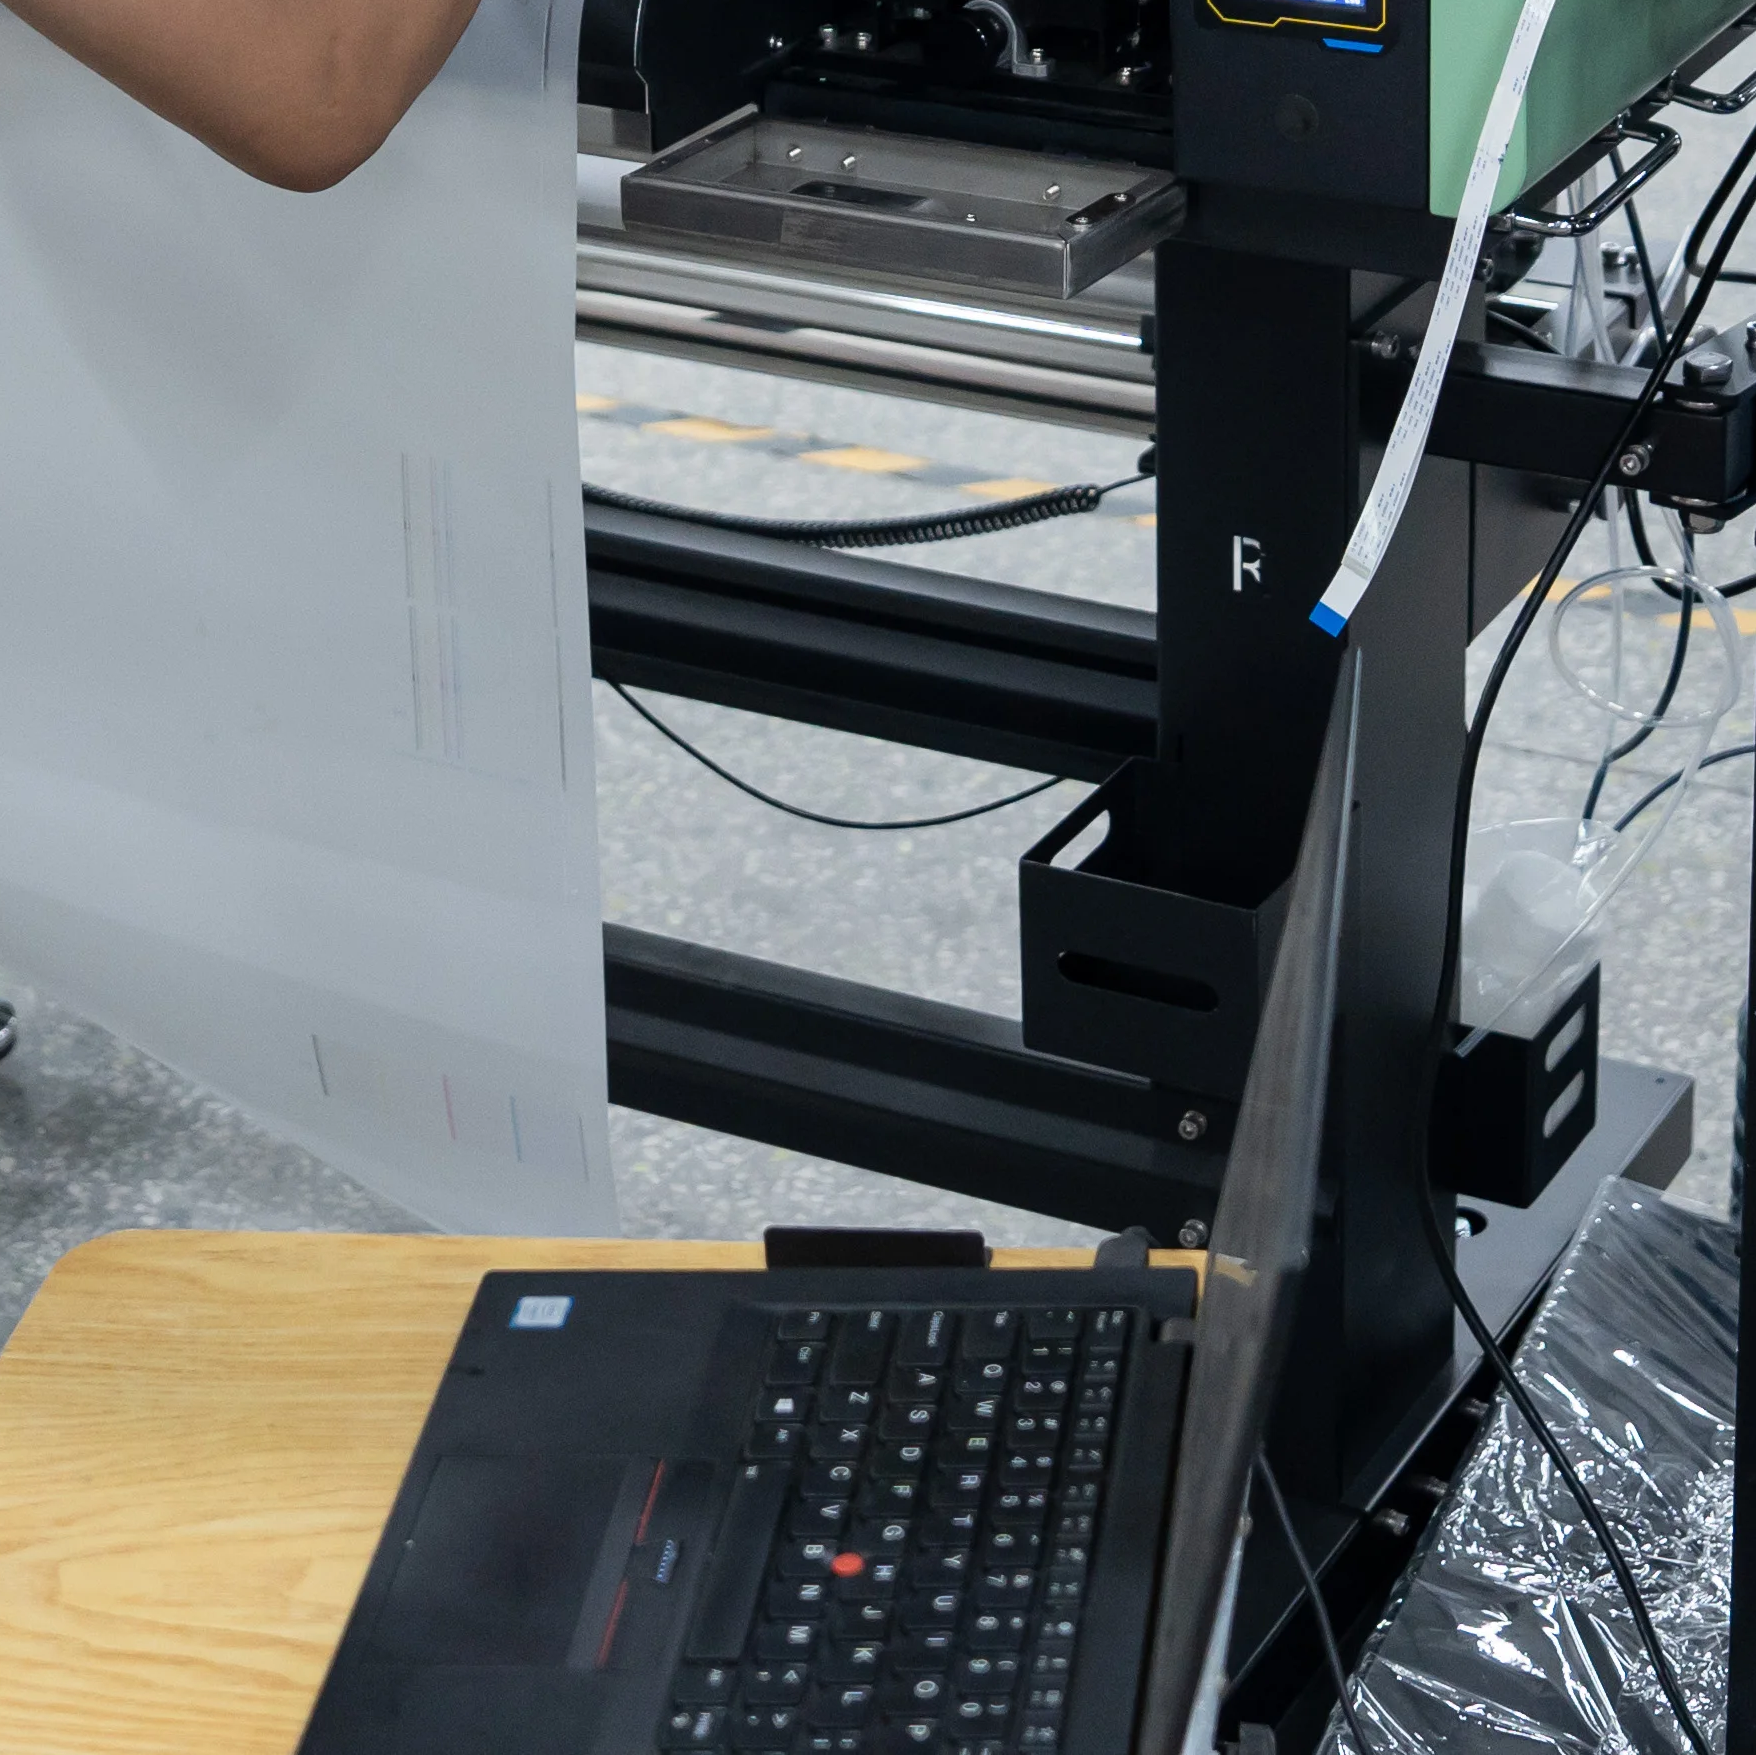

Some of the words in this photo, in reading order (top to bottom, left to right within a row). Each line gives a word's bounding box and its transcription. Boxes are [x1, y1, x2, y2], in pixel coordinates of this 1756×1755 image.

[1233, 535, 1266, 592] R
[807, 1311, 821, 1324] Fn
[927, 1310, 945, 1347] CapsLock
[982, 1363, 1004, 1378] Q
[917, 1371, 938, 1387] A
[1024, 1380, 1043, 1394] 2
[848, 1391, 870, 1404] Z
[908, 1409, 930, 1423] S
[974, 1400, 995, 1418] W
[1016, 1417, 1036, 1431] 3
[839, 1428, 860, 1442] X
[966, 1437, 989, 1451] E
[900, 1447, 922, 1461] D
[1009, 1456, 1028, 1469] 4
[829, 1466, 852, 1481] C
[959, 1474, 981, 1490] R
[891, 1485, 913, 1498] F
[1000, 1495, 1021, 1508] 5
[820, 1504, 841, 1519] V
[951, 1514, 974, 1528] T
[882, 1525, 905, 1541] G
[993, 1533, 1015, 1547] 6
[803, 1544, 825, 1559] B
[942, 1554, 963, 1569] Y
[873, 1565, 895, 1581] H
[986, 1574, 1007, 1588] 7
[800, 1584, 822, 1601] N
[932, 1595, 956, 1611] U
[861, 1605, 884, 1620] J
[976, 1616, 999, 1630] 8
[788, 1625, 811, 1644] M
[852, 1647, 876, 1664] K
[968, 1659, 991, 1674] 9
[914, 1680, 939, 1698] O
[841, 1691, 866, 1706] L
[958, 1702, 983, 1718] 0
[907, 1724, 931, 1742] P
